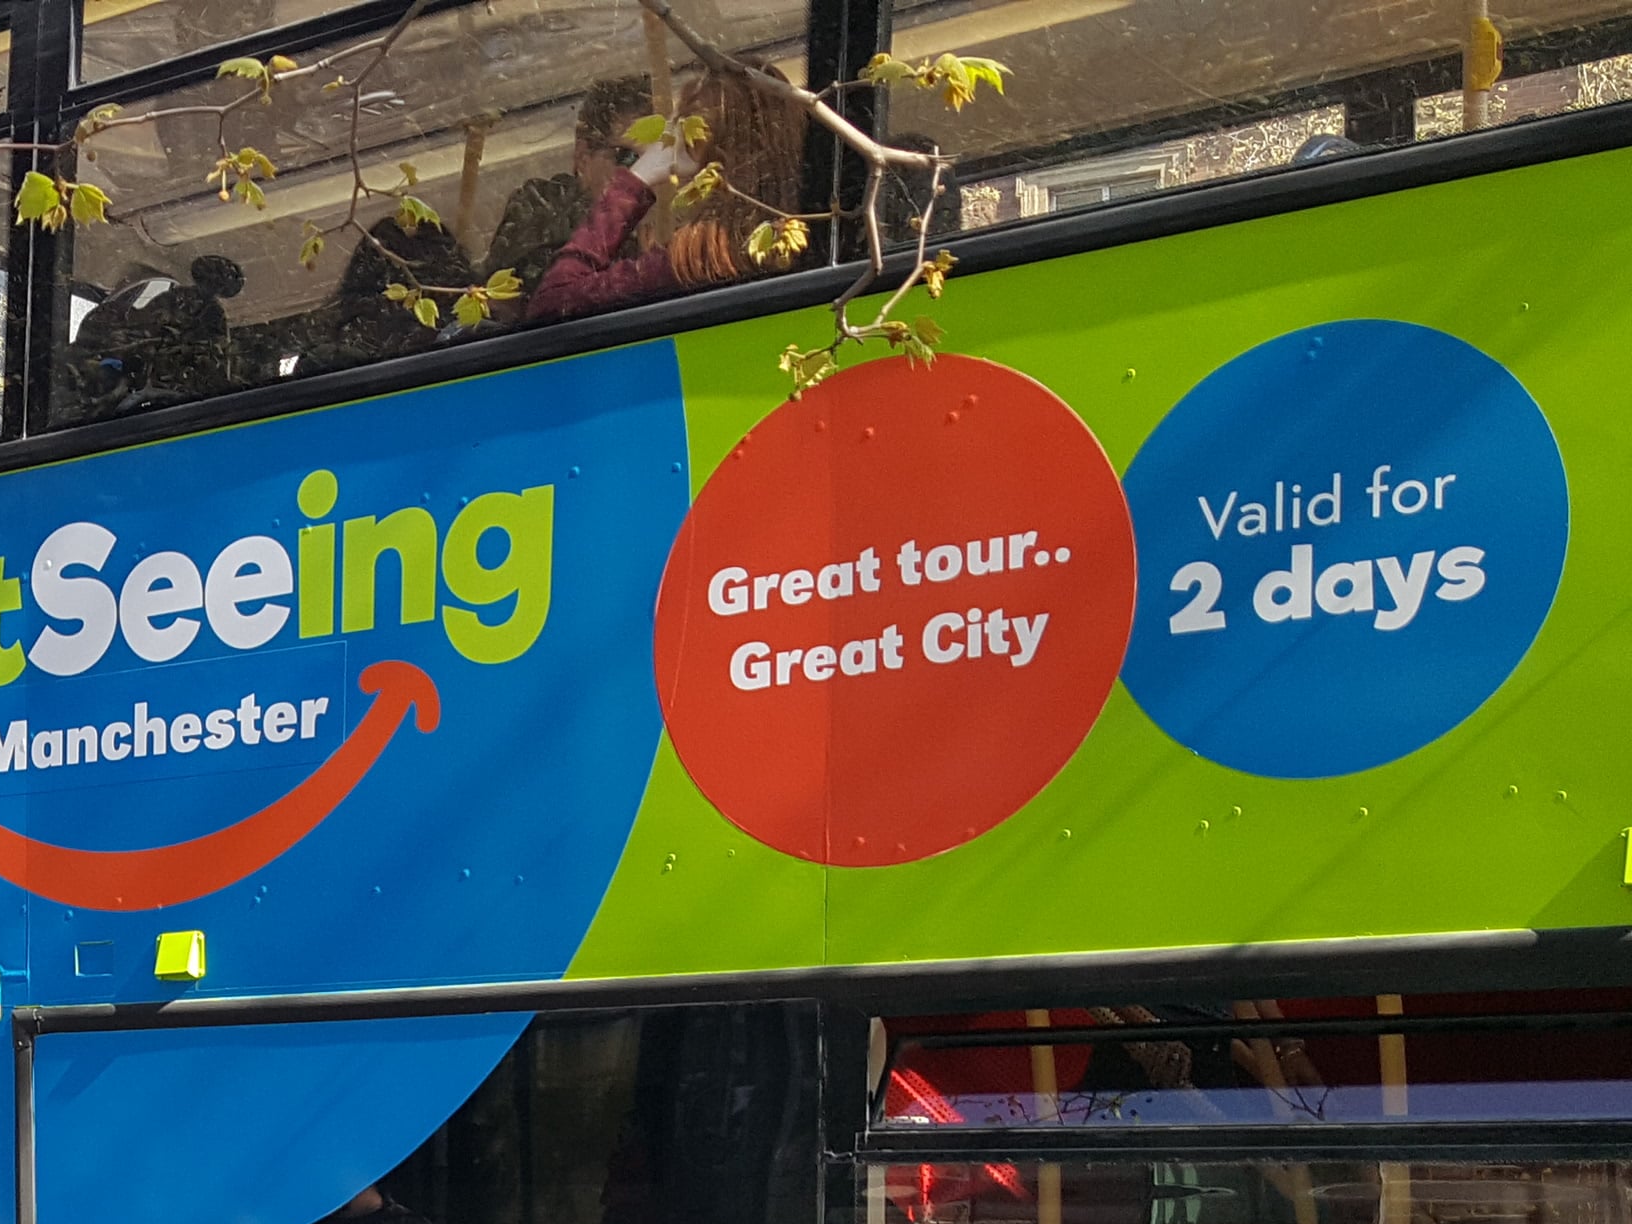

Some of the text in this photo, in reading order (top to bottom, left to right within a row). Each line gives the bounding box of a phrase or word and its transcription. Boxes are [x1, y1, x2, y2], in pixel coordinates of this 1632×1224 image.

[1197, 464, 1456, 541] Valid for
[707, 530, 1071, 616] Great tour..
[1169, 543, 1486, 634] 2 days
[729, 608, 1050, 691] Great City
